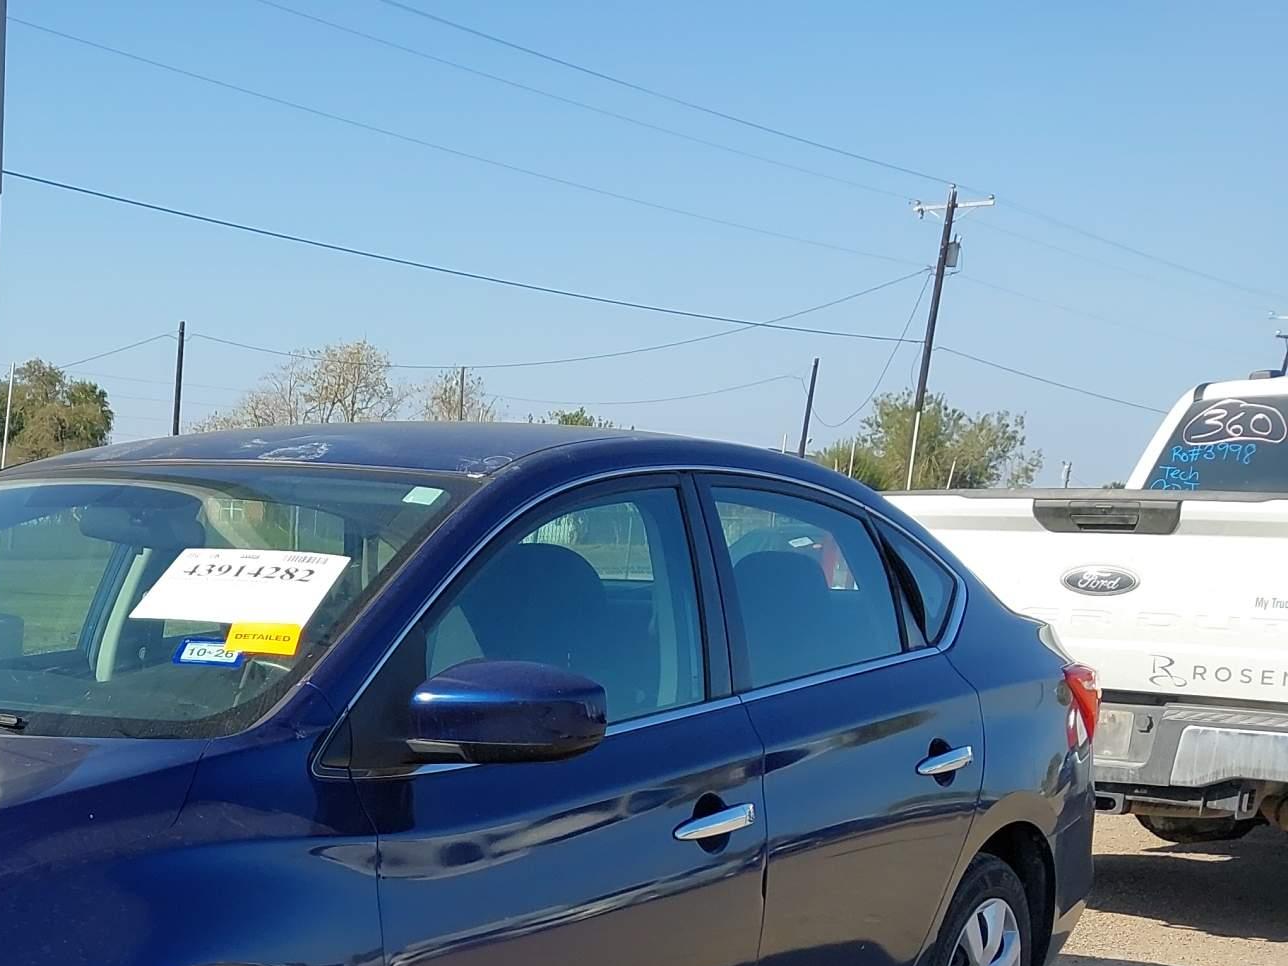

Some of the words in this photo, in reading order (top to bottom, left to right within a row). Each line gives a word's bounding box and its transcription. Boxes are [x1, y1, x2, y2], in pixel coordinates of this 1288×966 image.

[1191, 409, 1272, 439] 360
[1159, 465, 1200, 480] Tech
[183, 563, 316, 583] 43914282
[1255, 597, 1270, 611] My
[234, 633, 291, 642] DETAILED
